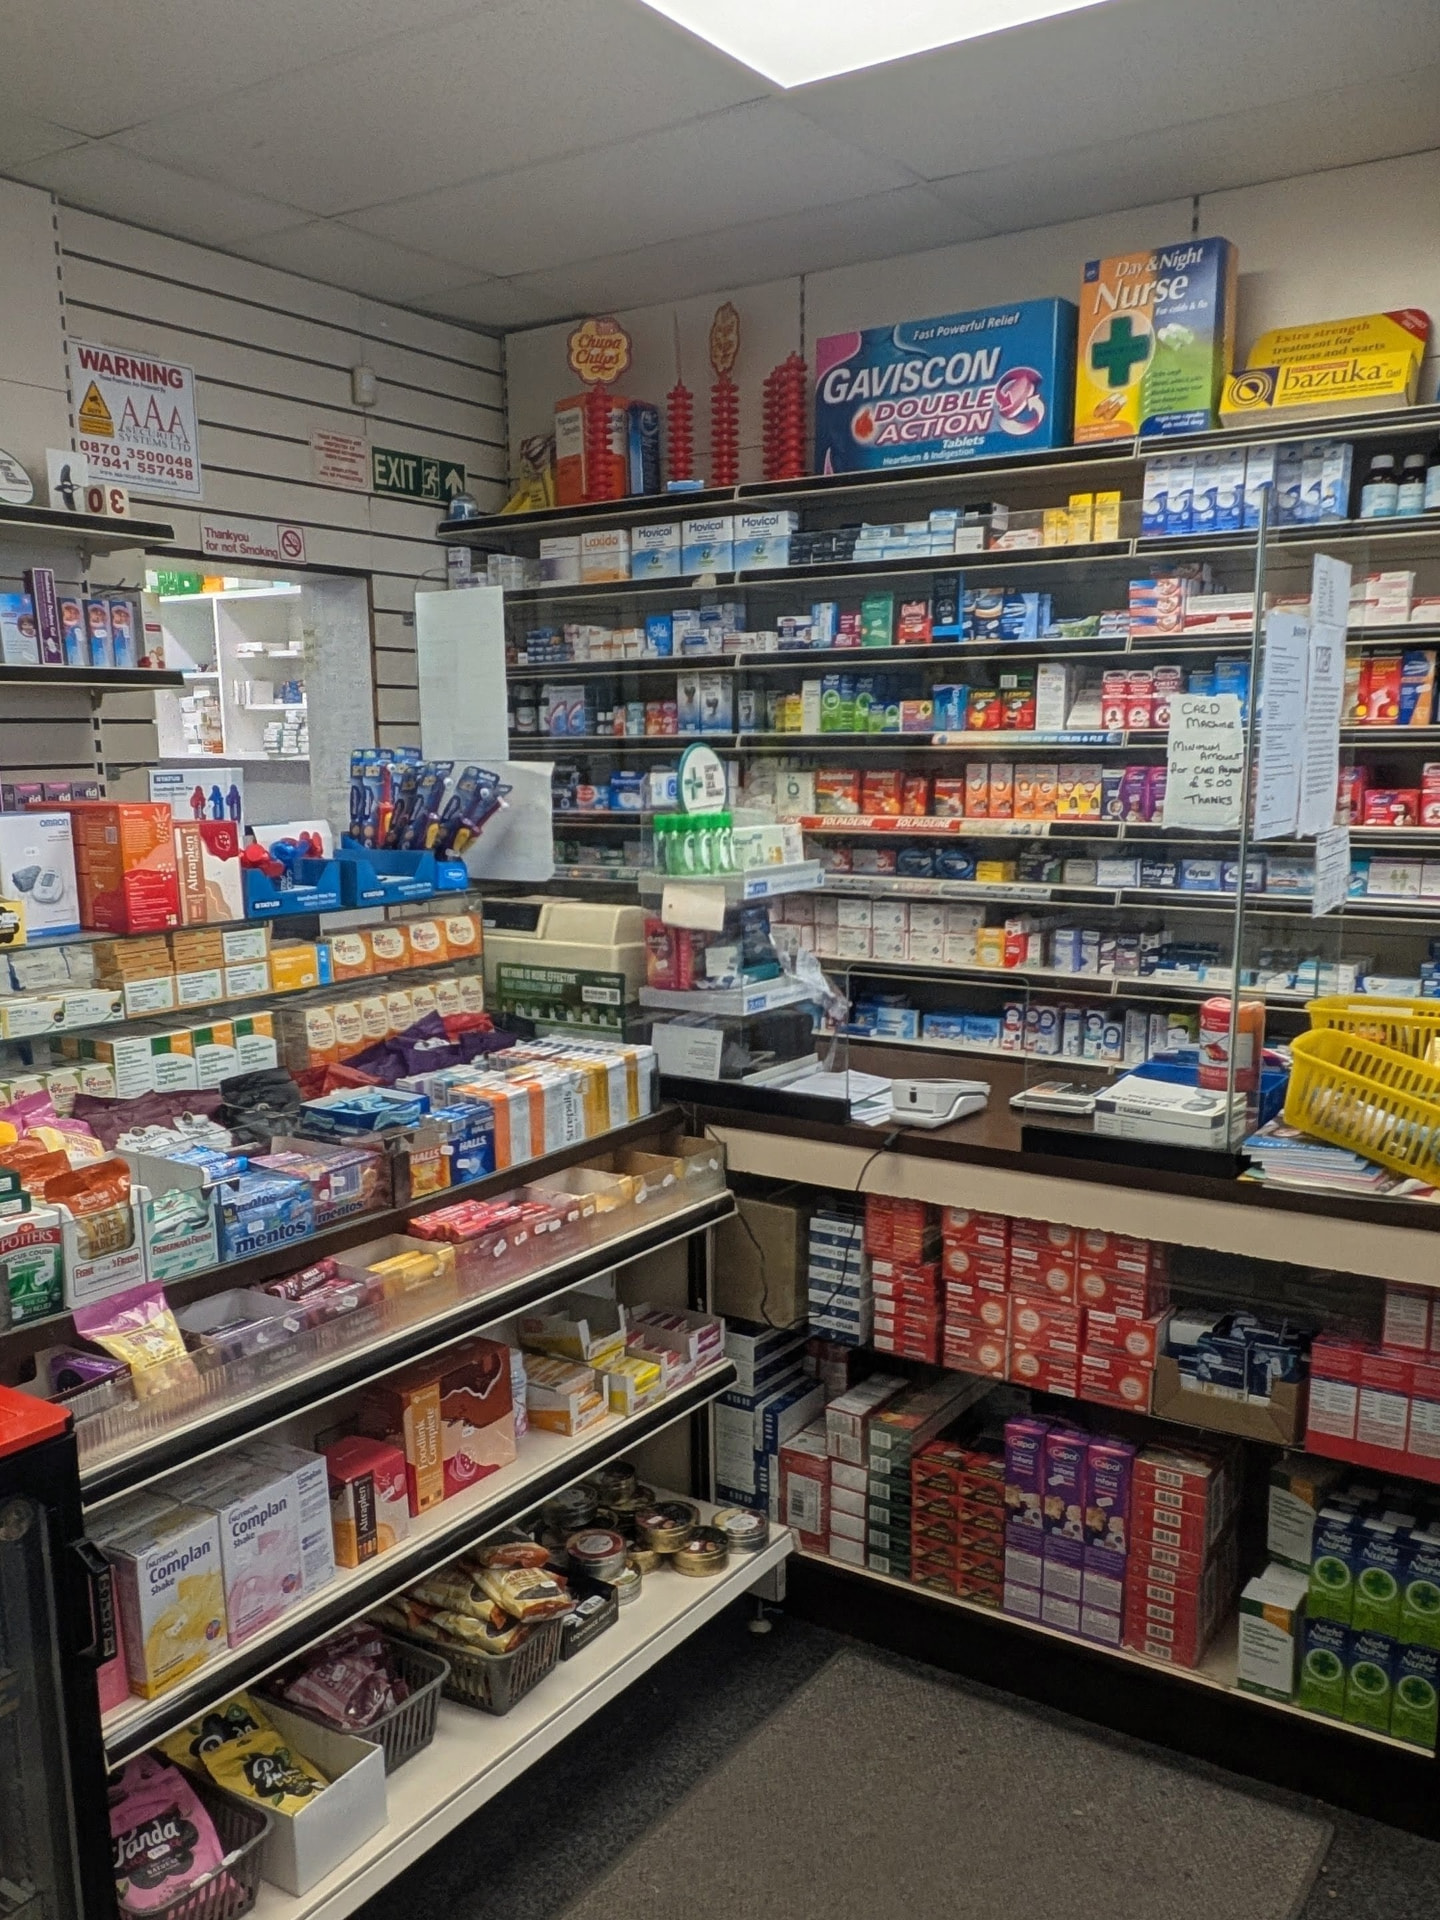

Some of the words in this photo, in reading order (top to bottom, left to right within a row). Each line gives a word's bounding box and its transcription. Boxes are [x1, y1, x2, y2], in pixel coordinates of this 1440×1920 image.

[1115, 261, 1143, 278] Day
[1146, 255, 1158, 272] &
[1159, 247, 1203, 271] Night
[1093, 274, 1188, 315] Nurse
[914, 329, 934, 341] Fast
[936, 319, 986, 337] Powerful
[987, 312, 1020, 328] Relief
[1275, 331, 1310, 344] Extra
[1314, 321, 1370, 338] strength
[579, 334, 622, 351] Chupa
[1273, 341, 1331, 355] treatment
[1334, 336, 1354, 346] for
[1324, 347, 1348, 359] and
[1352, 342, 1386, 353] warts
[77, 347, 184, 389] WARNING
[575, 350, 620, 373] Chups
[823, 347, 1000, 404] GAVISCON
[1283, 359, 1382, 391] bazuka
[875, 387, 996, 423] DOUBLE
[118, 394, 190, 444] AAA
[876, 409, 992, 447] ACTION
[118, 432, 168, 449] SYSTEMS
[171, 439, 191, 452] LTD
[943, 436, 985, 449] Tablets
[80, 440, 120, 456] 0870
[126, 448, 193, 468] 3500048
[883, 453, 921, 466] Heartburn
[923, 452, 929, 461] &
[931, 448, 975, 462] Indigestion
[137, 463, 193, 480] 557458
[374, 453, 417, 491] EXIT
[689, 520, 723, 533] Movicol
[741, 515, 779, 527] Movicol
[204, 526, 249, 543] Thankyou
[638, 526, 672, 539] Movicol
[205, 540, 218, 551] for
[221, 543, 237, 553] not
[240, 543, 278, 559] Smoking
[584, 534, 618, 549] Laxido
[1182, 702, 1220, 715] CARD
[39, 818, 69, 827] OMRON
[255, 900, 280, 909] STATUS
[564, 1090, 575, 1142] Strepsils
[459, 1136, 487, 1151] HALLS
[410, 1149, 440, 1165] HALLS
[317, 1199, 364, 1222] mentos
[0, 1230, 53, 1252] POTTERS
[235, 1219, 307, 1255] mentos
[1012, 1438, 1035, 1450] Calpol
[1053, 1447, 1077, 1461] Calpol
[1095, 1459, 1120, 1472] Calpol
[232, 1498, 287, 1537] Complan
[233, 1532, 256, 1549] Shake
[1317, 1537, 1352, 1553] Nurse
[1322, 1531, 1353, 1545] Night
[1363, 1548, 1398, 1565] Nurse
[1368, 1542, 1399, 1556] Night
[149, 1540, 211, 1584] Complan
[1416, 1554, 1440, 1567] Nigh
[151, 1577, 176, 1596] Shake
[1308, 1630, 1343, 1646] Nurse
[1315, 1624, 1345, 1639] Night
[1354, 1643, 1389, 1660] Nurse
[1360, 1637, 1390, 1652] Night
[1401, 1656, 1437, 1674] Nurse
[1407, 1649, 1438, 1665] Night
[113, 1820, 181, 1869] Panda
